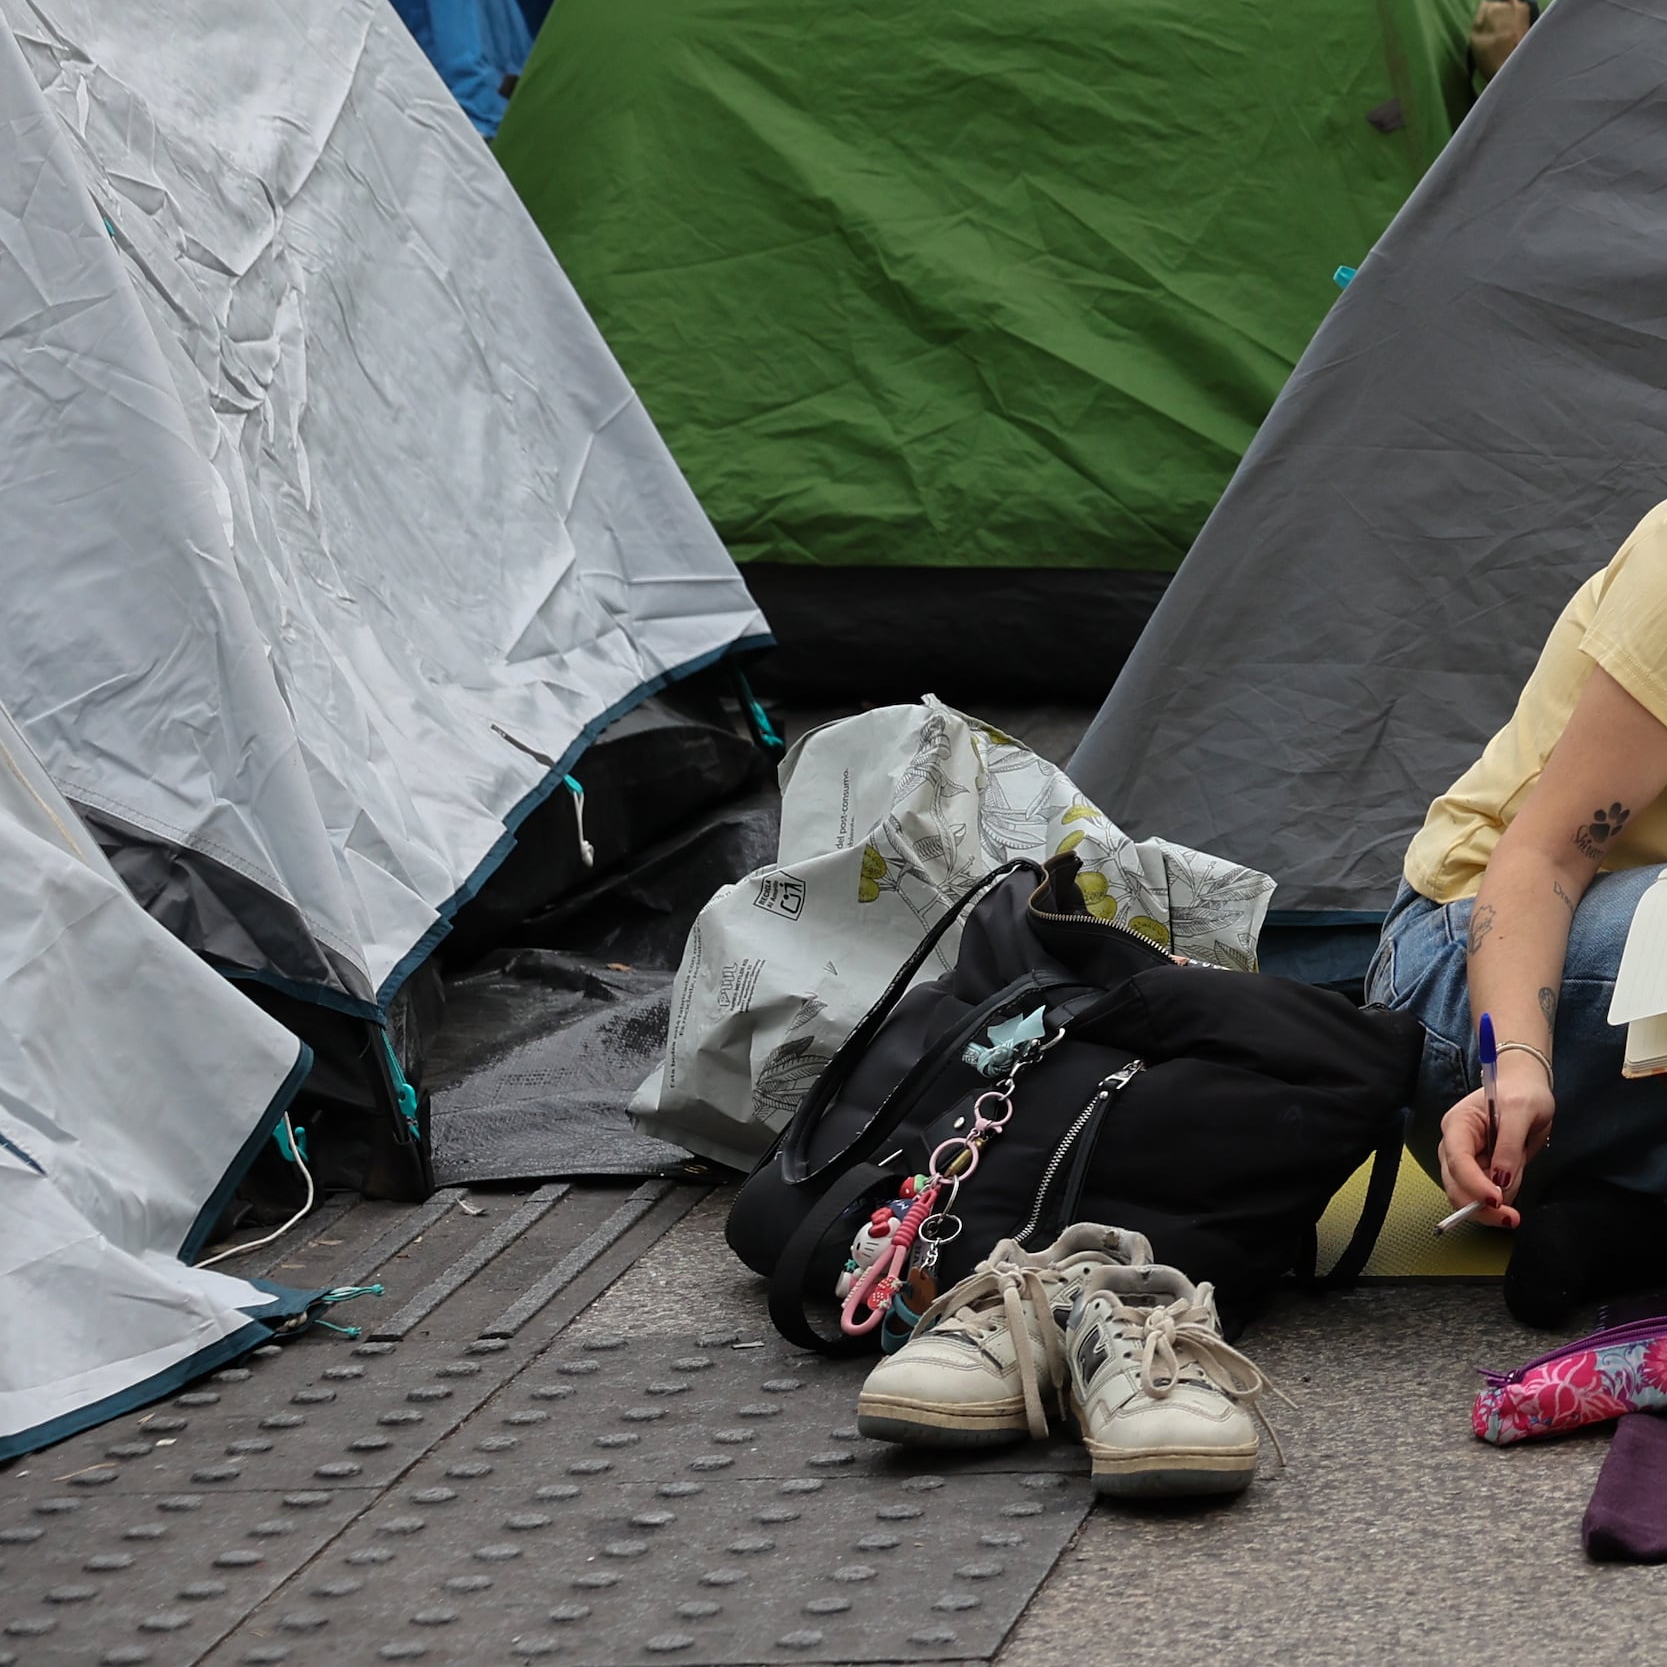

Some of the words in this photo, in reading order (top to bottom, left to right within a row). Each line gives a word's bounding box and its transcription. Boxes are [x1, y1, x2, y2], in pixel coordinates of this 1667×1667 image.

[835, 836, 845, 850] del
[840, 768, 850, 834] post-consumo.
[688, 956, 696, 973] con
